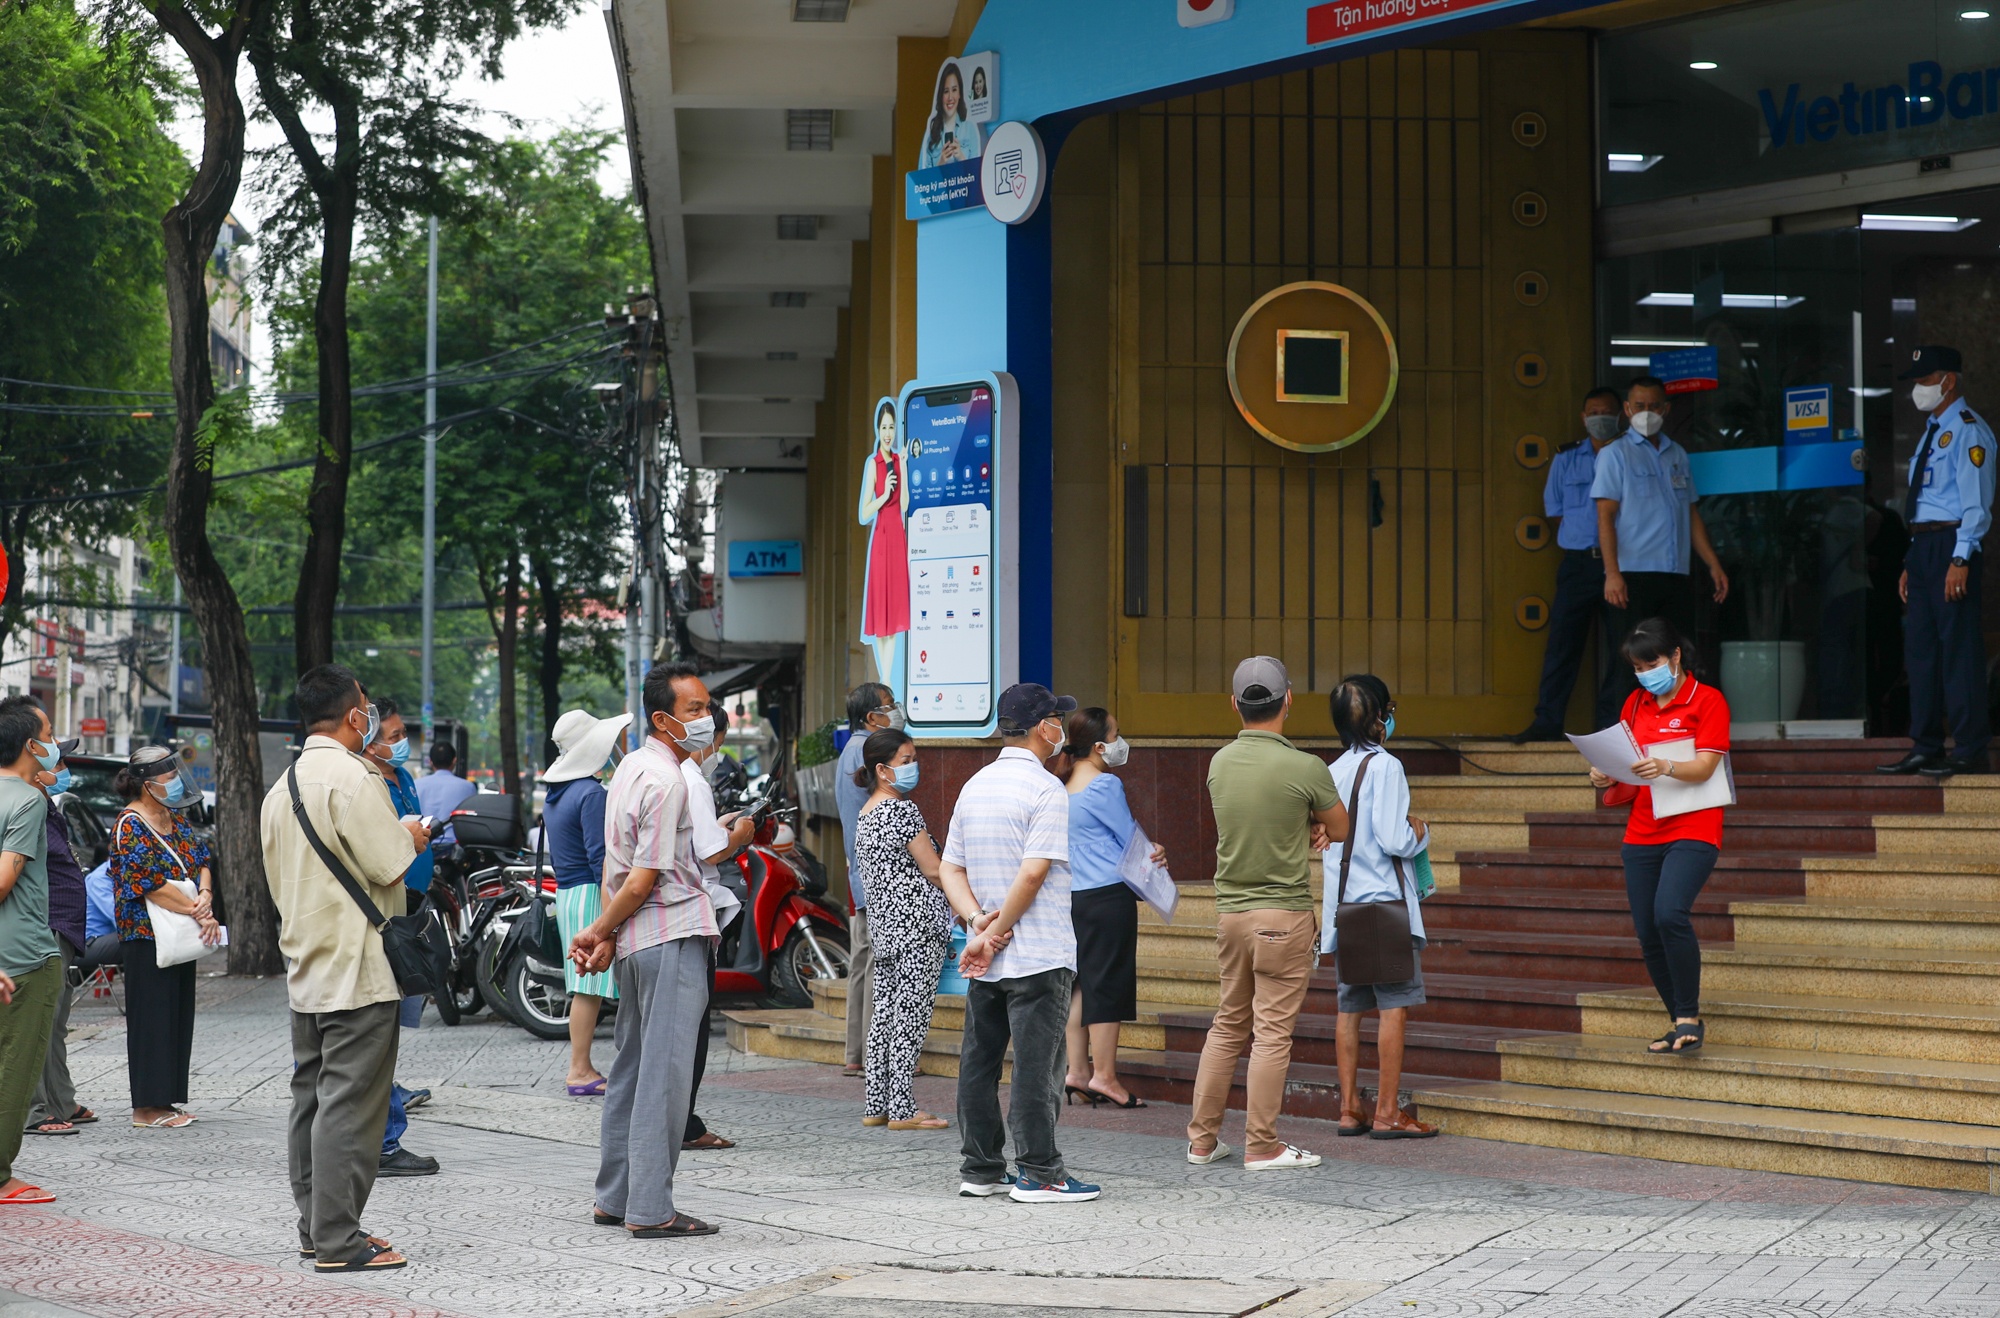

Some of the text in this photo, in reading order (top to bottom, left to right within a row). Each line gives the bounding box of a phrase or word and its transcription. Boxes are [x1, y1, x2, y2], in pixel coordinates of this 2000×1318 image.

[1334, 6, 1362, 31] Tận
[914, 184, 930, 194] Đăng
[931, 181, 937, 191] ký
[957, 173, 975, 184] khoản
[920, 186, 968, 205] trực tuyến (eKYC)
[1795, 402, 1820, 417] VISA
[744, 551, 786, 568] ATM
